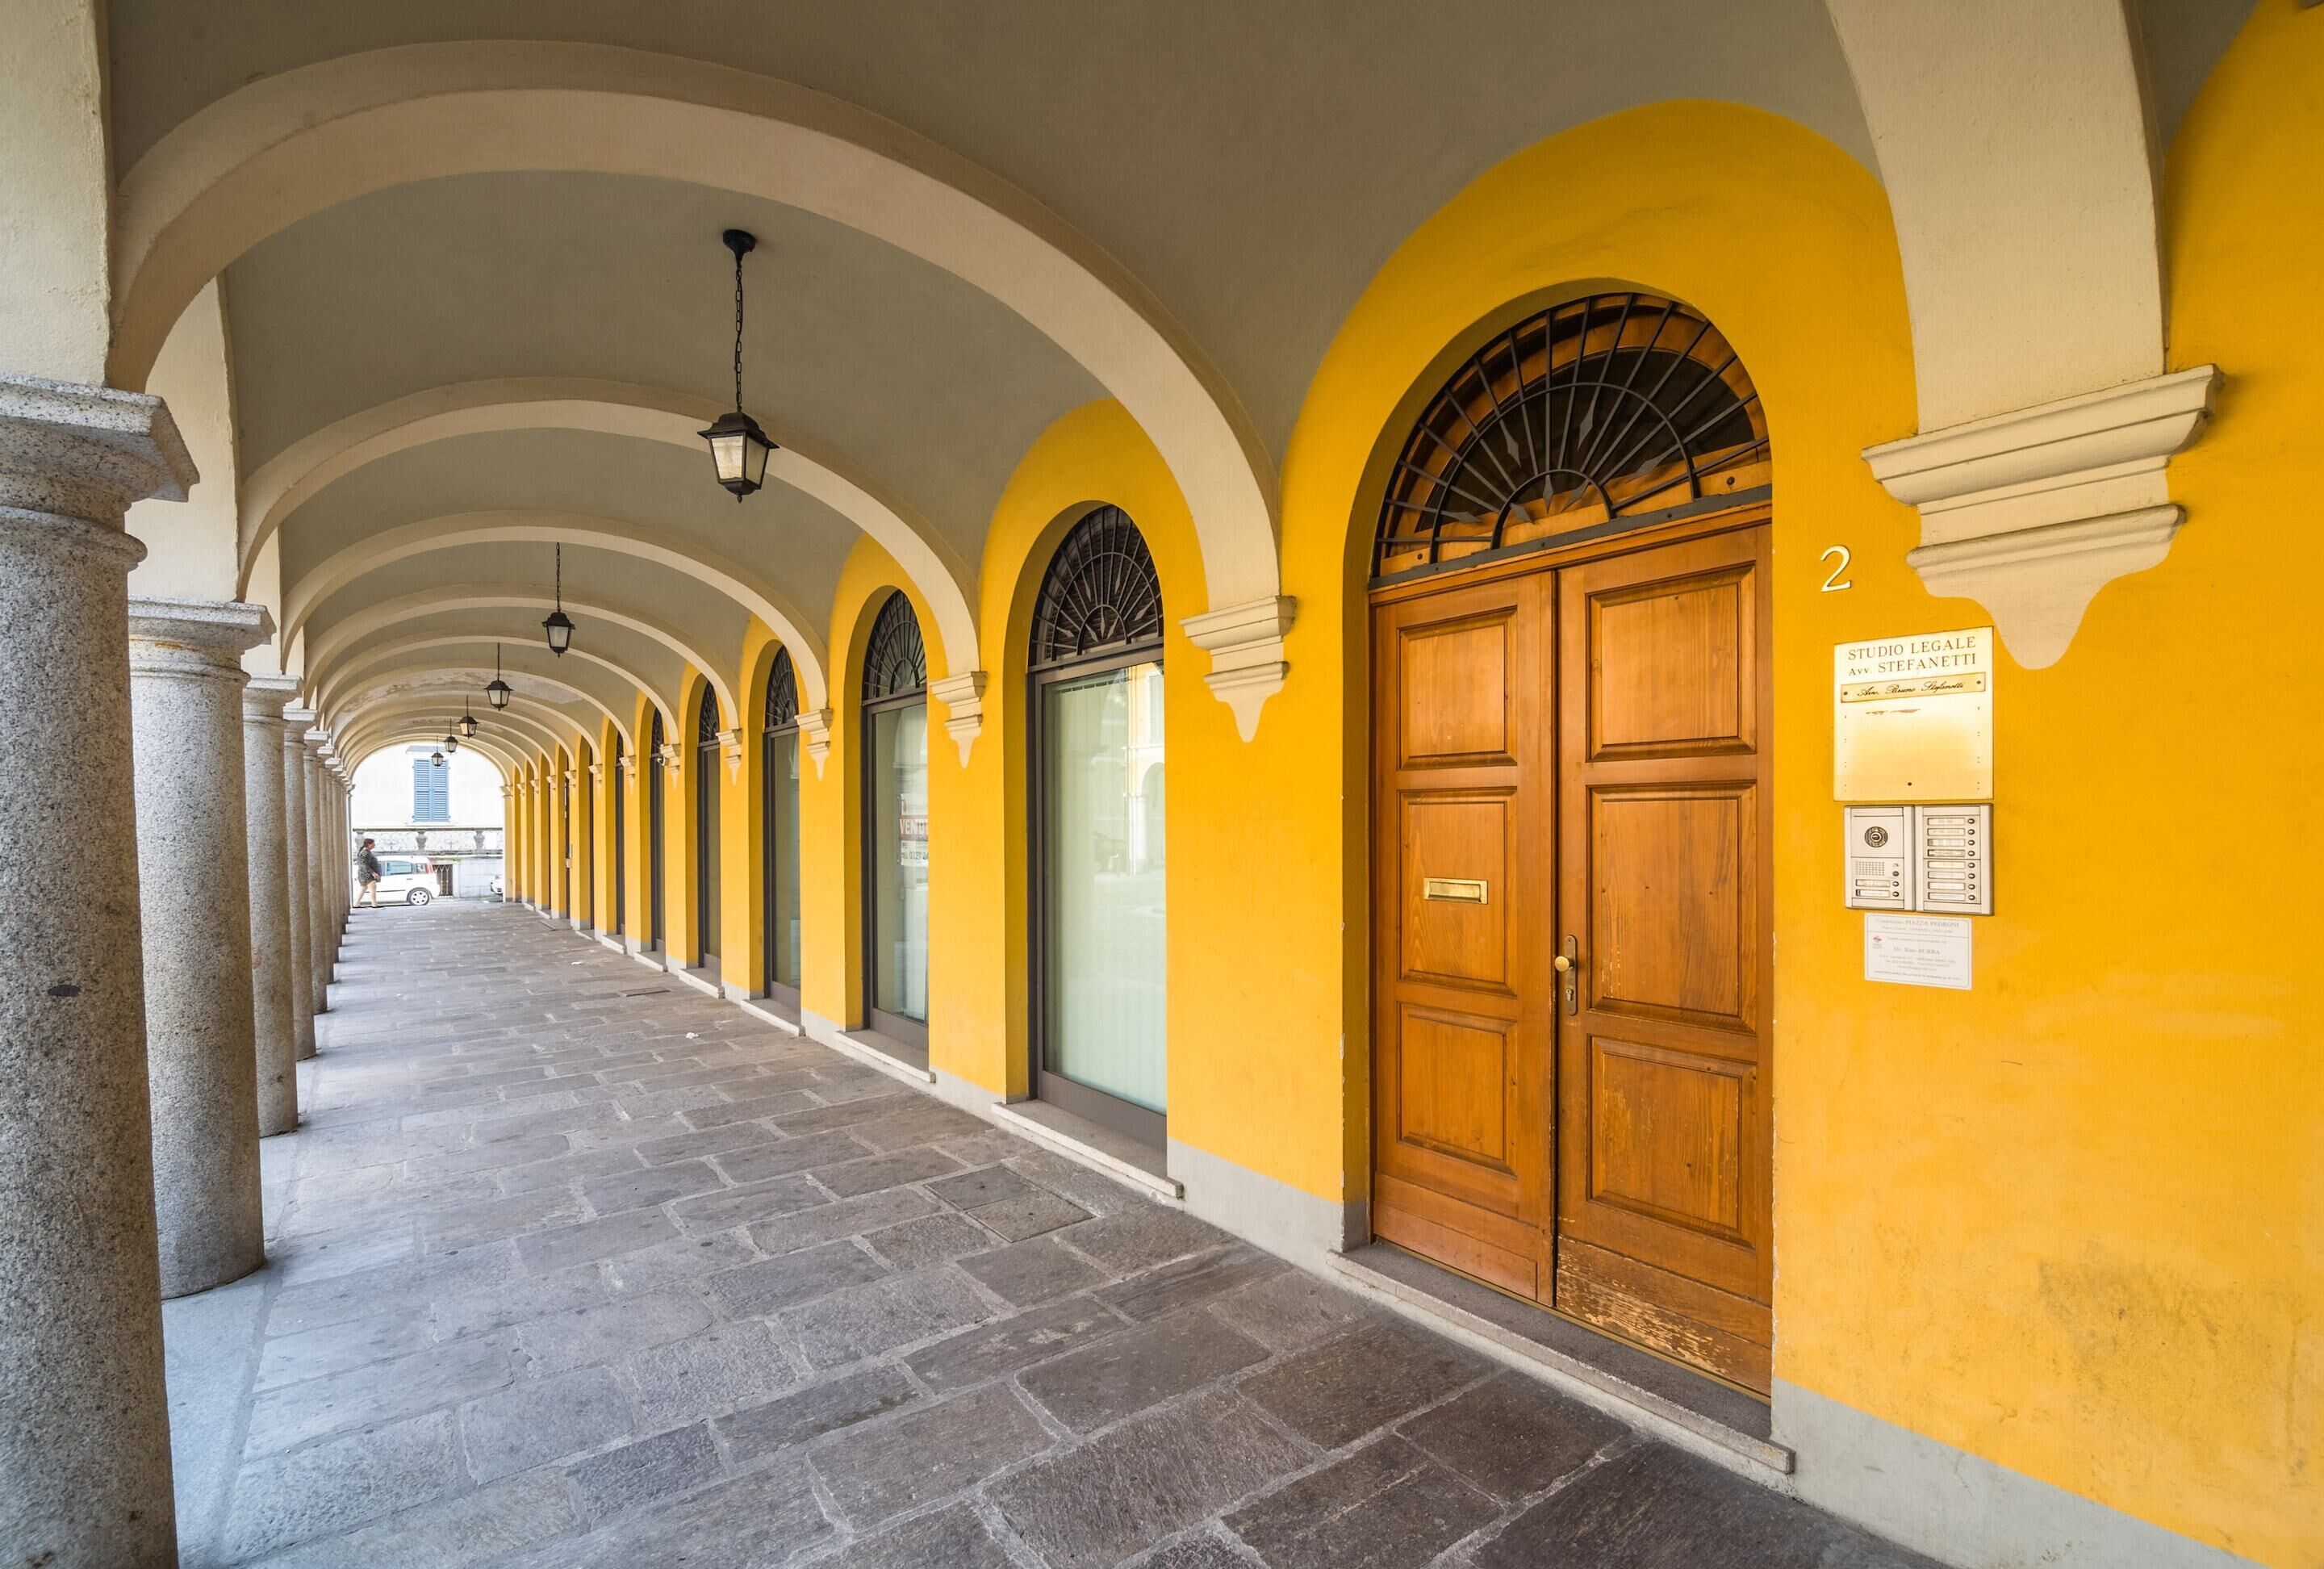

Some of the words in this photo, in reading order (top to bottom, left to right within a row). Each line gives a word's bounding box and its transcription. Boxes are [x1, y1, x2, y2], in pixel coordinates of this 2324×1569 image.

[1820, 544, 1852, 593] 2
[1848, 644, 1904, 660] STUDIO
[1911, 636, 1976, 655] LEGALE
[1878, 653, 1976, 673] STEFANETTI
[1886, 684, 1916, 694] Bruno
[1921, 680, 1965, 693] Stefanetti
